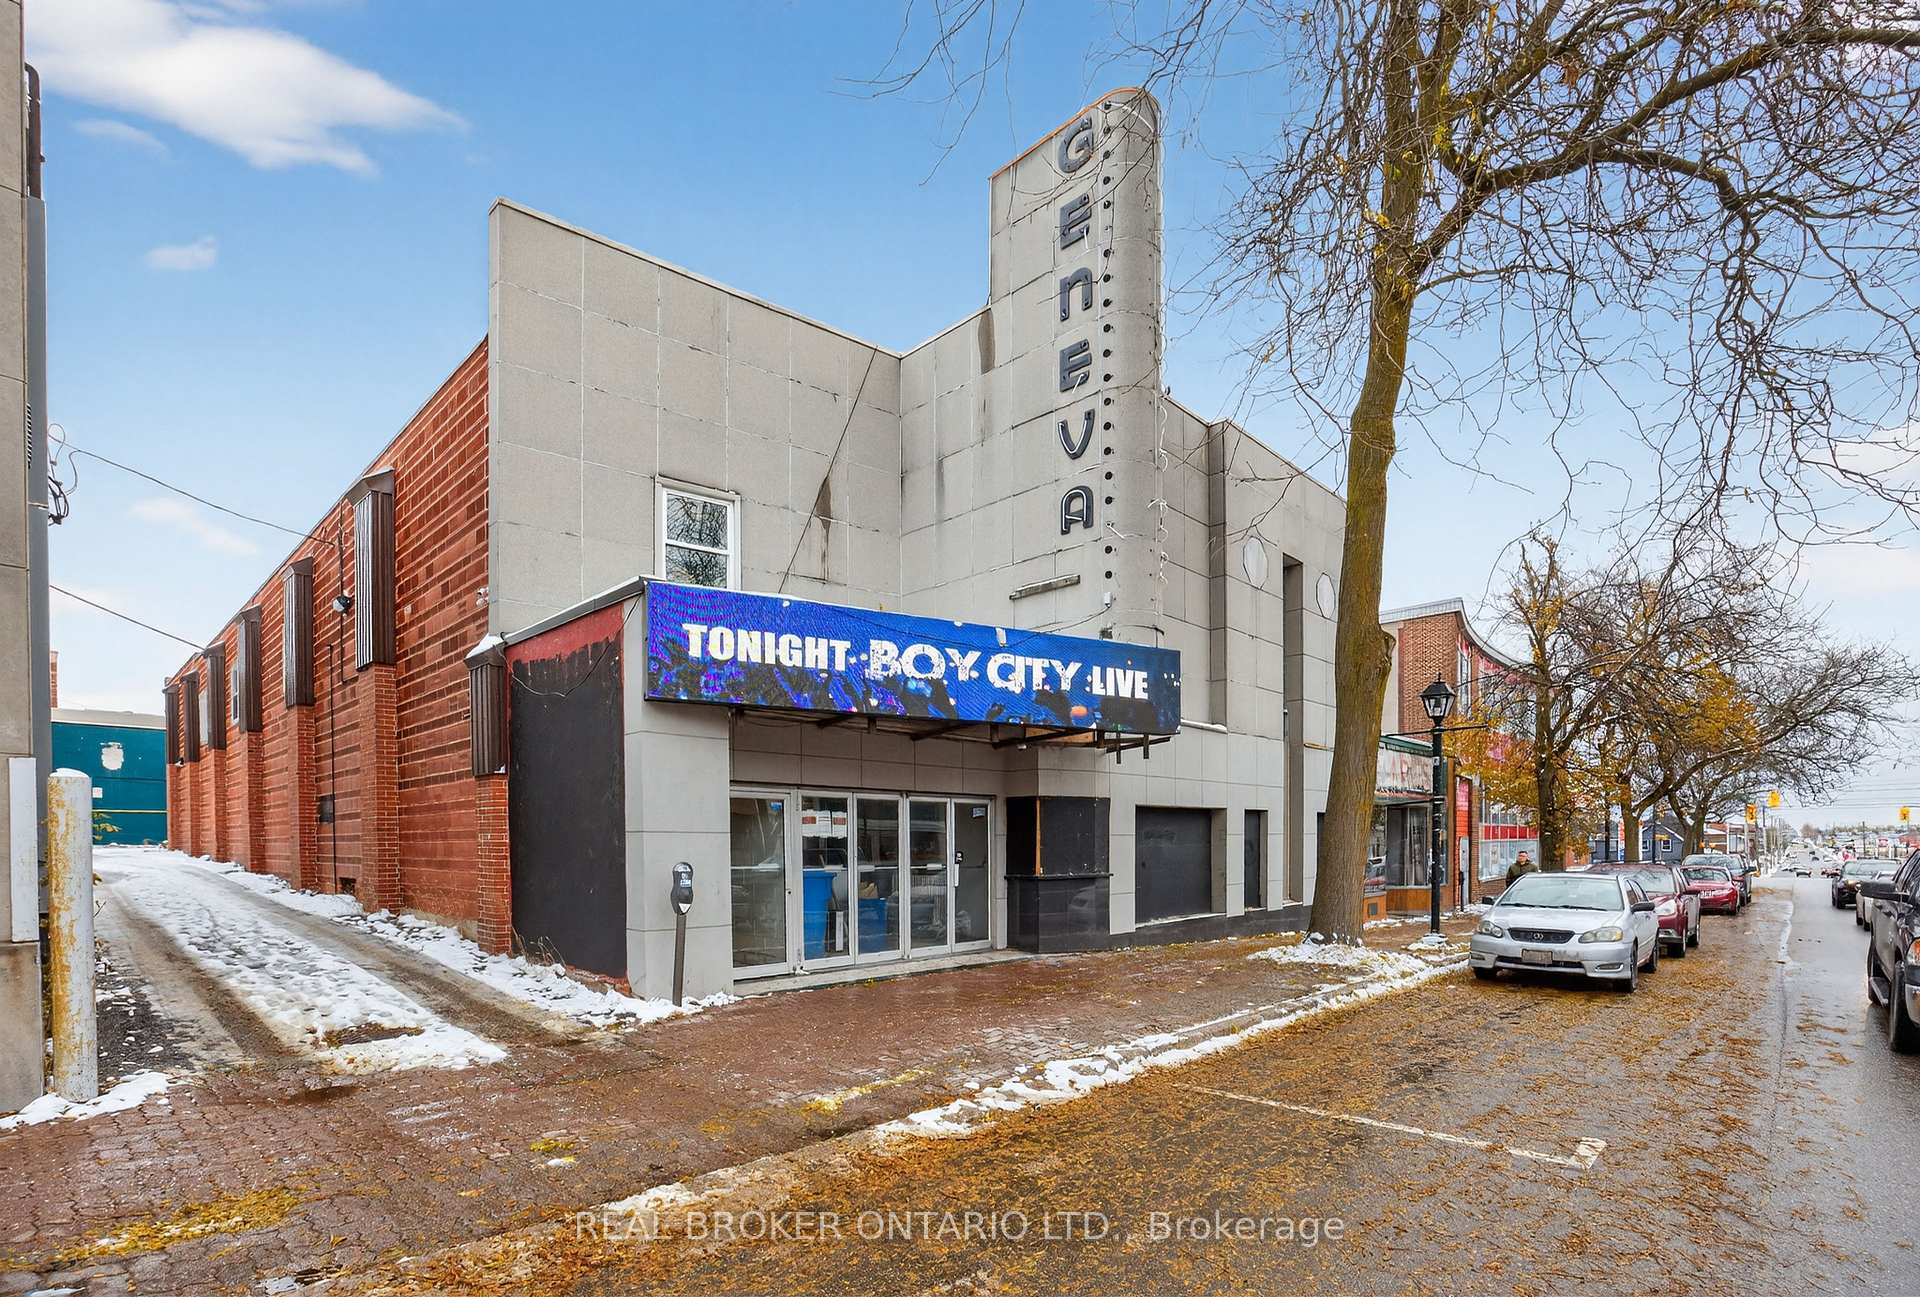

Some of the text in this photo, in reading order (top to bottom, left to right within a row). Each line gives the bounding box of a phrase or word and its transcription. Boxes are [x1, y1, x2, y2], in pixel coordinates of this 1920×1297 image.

[682, 623, 1148, 699] TONIGHT BOY CITY LIVE
